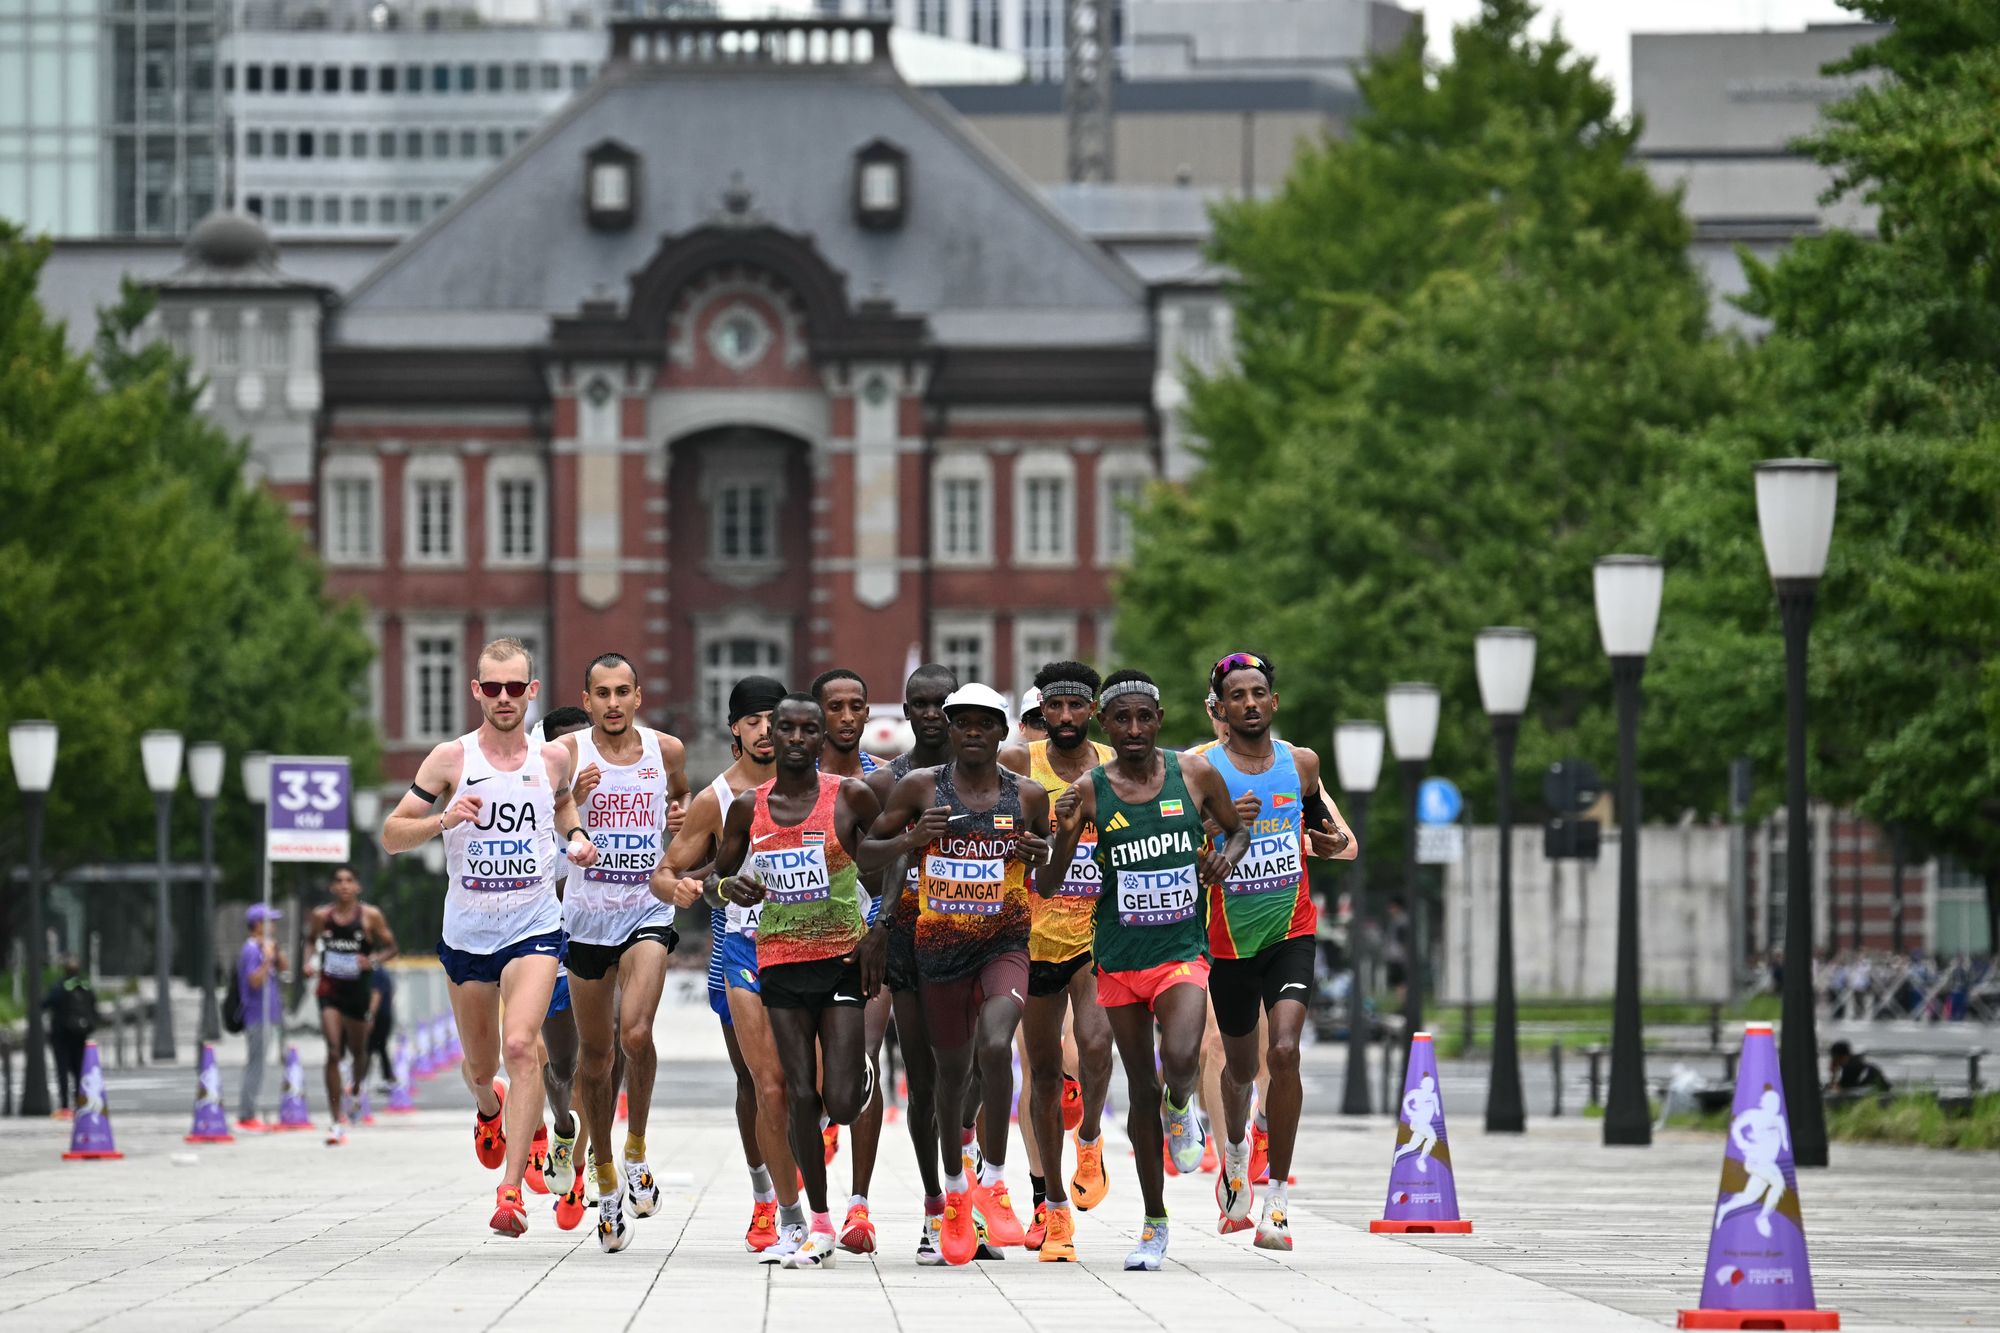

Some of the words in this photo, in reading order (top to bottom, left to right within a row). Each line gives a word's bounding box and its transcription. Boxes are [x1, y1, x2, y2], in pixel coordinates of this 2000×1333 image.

[278, 771, 341, 811] 33
[592, 792, 654, 811] GREAT
[474, 802, 536, 833] USA
[588, 810, 654, 828] BRITAIN
[1253, 817, 1292, 835] TREA
[483, 838, 533, 856] TDK
[609, 833, 656, 849] TDK
[940, 837, 1015, 858] UGANDA
[1111, 831, 1192, 867] ETHIOPIA
[1249, 835, 1294, 858] TDK
[467, 858, 536, 876] YOUNG
[766, 849, 819, 870] TDK
[946, 861, 998, 879] TDK
[1230, 854, 1297, 880] AMARE
[761, 868, 824, 890] KIMUTAI
[929, 879, 1001, 900] KIPLANGAT
[1138, 869, 1191, 889] TDK
[1123, 889, 1193, 910] GELETA
